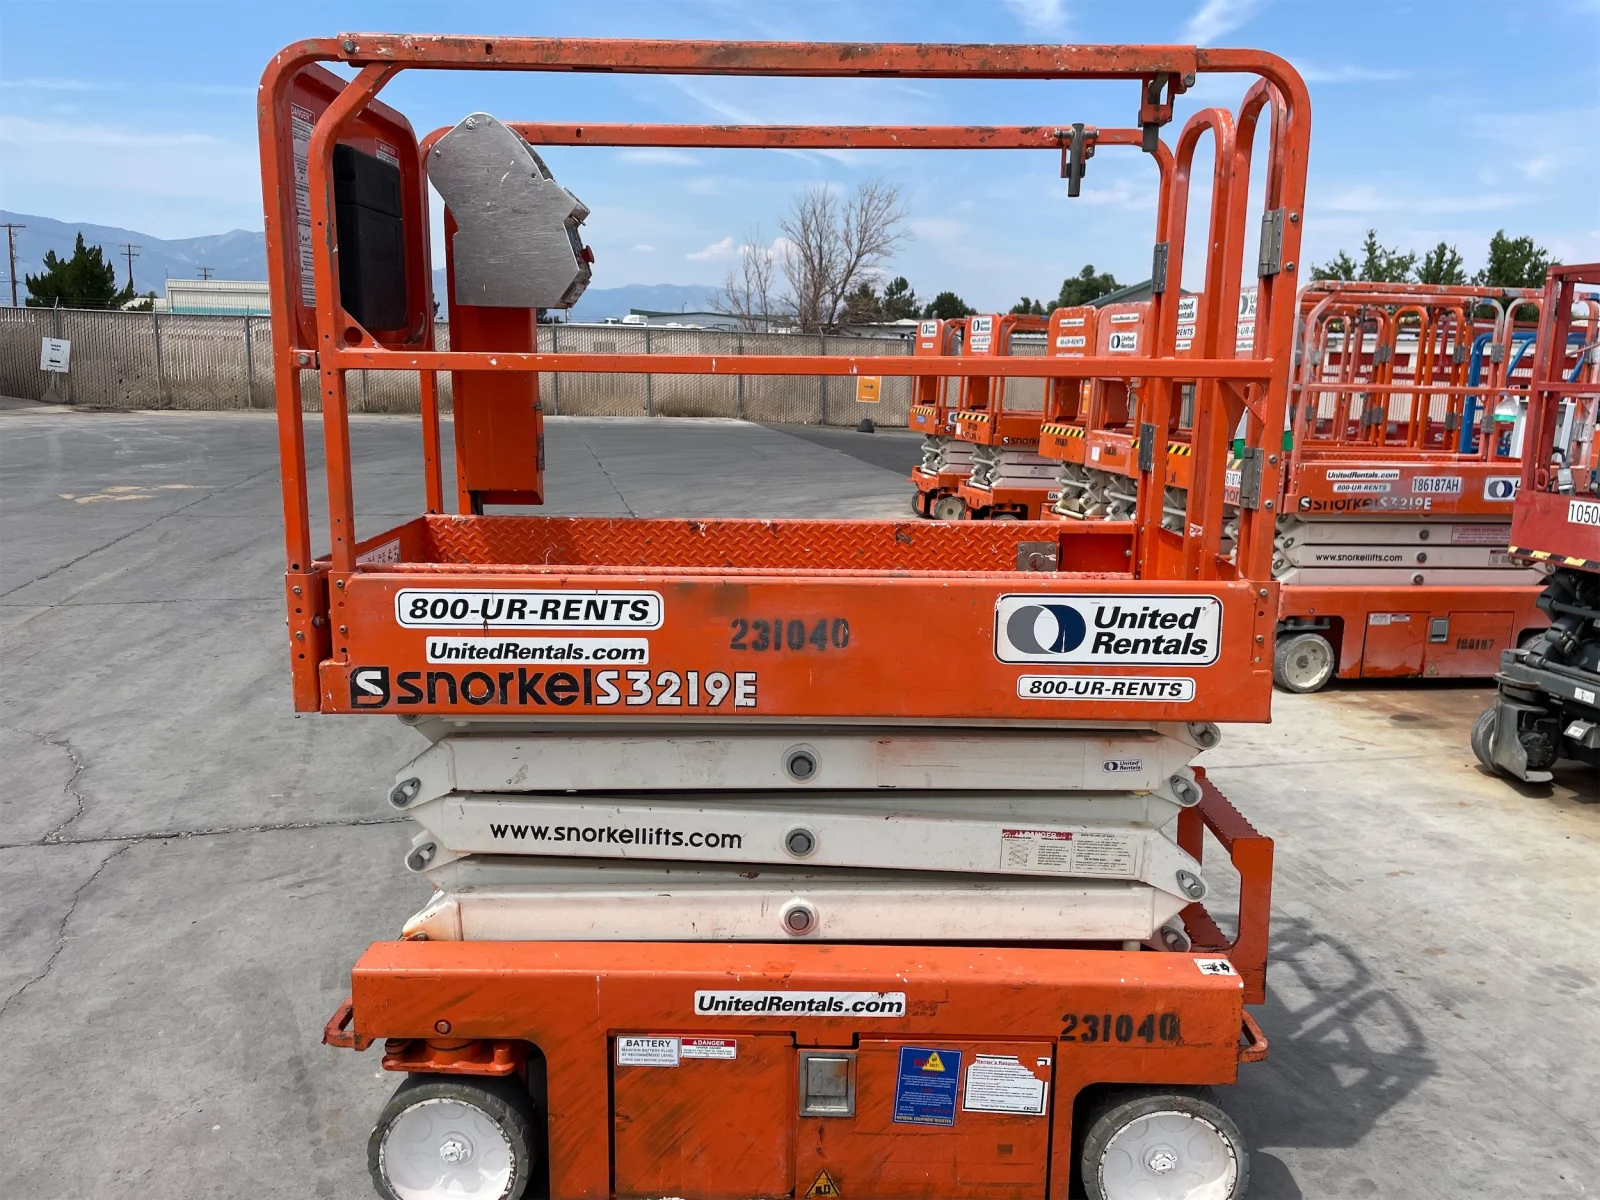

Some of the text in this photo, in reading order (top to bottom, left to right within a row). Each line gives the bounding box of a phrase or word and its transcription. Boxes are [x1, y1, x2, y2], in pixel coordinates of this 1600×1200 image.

[1328, 471, 1399, 479] UnitedRentals.com
[1413, 478, 1460, 492] 186187AH
[1571, 503, 1600, 525] 1050
[1316, 554, 1403, 562] www.snorkellifts.com
[409, 598, 650, 622] 800-UR-RENTS
[1093, 605, 1200, 629] United
[730, 618, 849, 650] 231040
[1091, 632, 1208, 655] Rentals
[430, 642, 645, 661] UnitedRentals.com
[1029, 680, 1183, 697] 800-UR-RENTS
[490, 823, 742, 849] www.snorkellifts.com
[699, 995, 903, 1013] UnitedRentals.com
[1060, 1013, 1179, 1043] 231040
[626, 1039, 672, 1048] BATTERY
